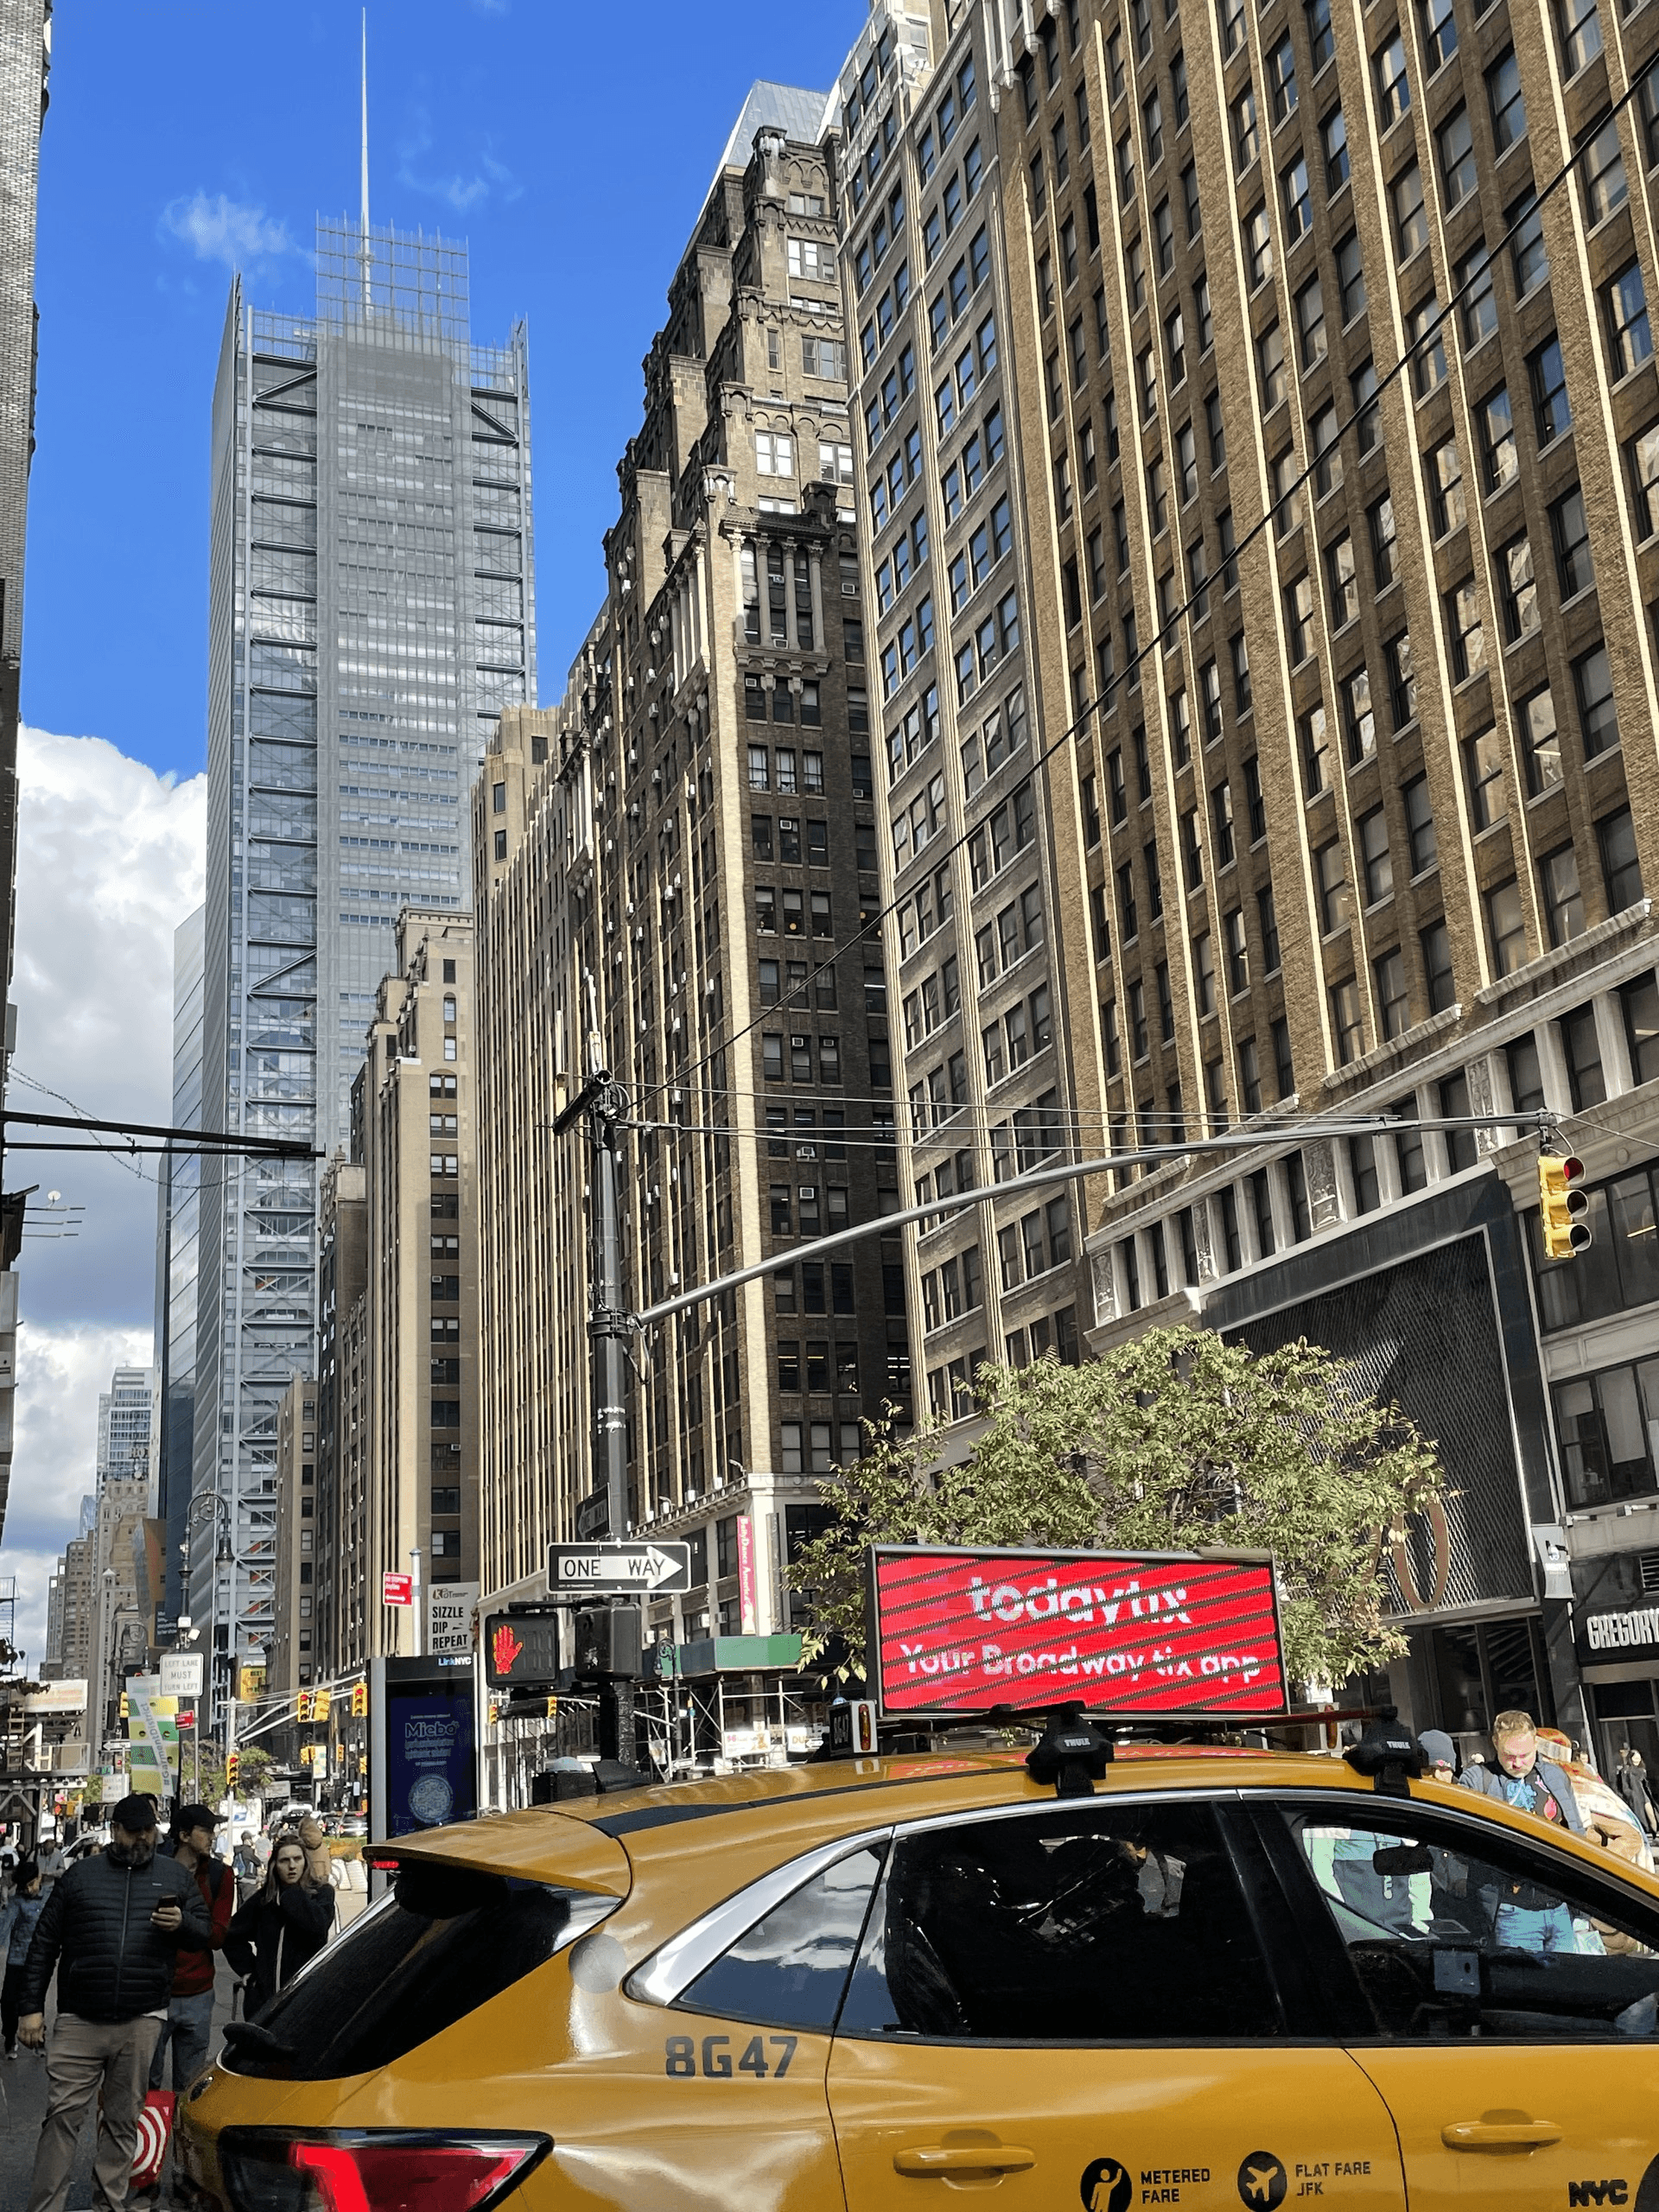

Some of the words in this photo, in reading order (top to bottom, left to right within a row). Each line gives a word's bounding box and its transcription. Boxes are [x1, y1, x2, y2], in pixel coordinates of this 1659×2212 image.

[564, 1559, 601, 1577] ONE
[627, 1558, 666, 1577] WAY
[432, 1606, 463, 1618] SIZZLE
[433, 1621, 448, 1634] DIP
[433, 1634, 467, 1649] REPEAT
[438, 1656, 472, 1666] LinkNYC
[899, 1644, 975, 1675] Your
[982, 1644, 1145, 1682] Broadway
[1152, 1645, 1193, 1676] tix
[1200, 1656, 1261, 1684] app
[1064, 1738, 1090, 1746] THULE
[1386, 1740, 1411, 1750] THULE
[665, 2036, 798, 2078] 8G47
[1141, 2168, 1211, 2184] METERED
[1296, 2163, 1330, 2177] FLAT
[1335, 2161, 1371, 2176] FARE
[1141, 2189, 1179, 2203] FARE
[1297, 2182, 1324, 2196] JFK
[1568, 2179, 1628, 2208] NYC
